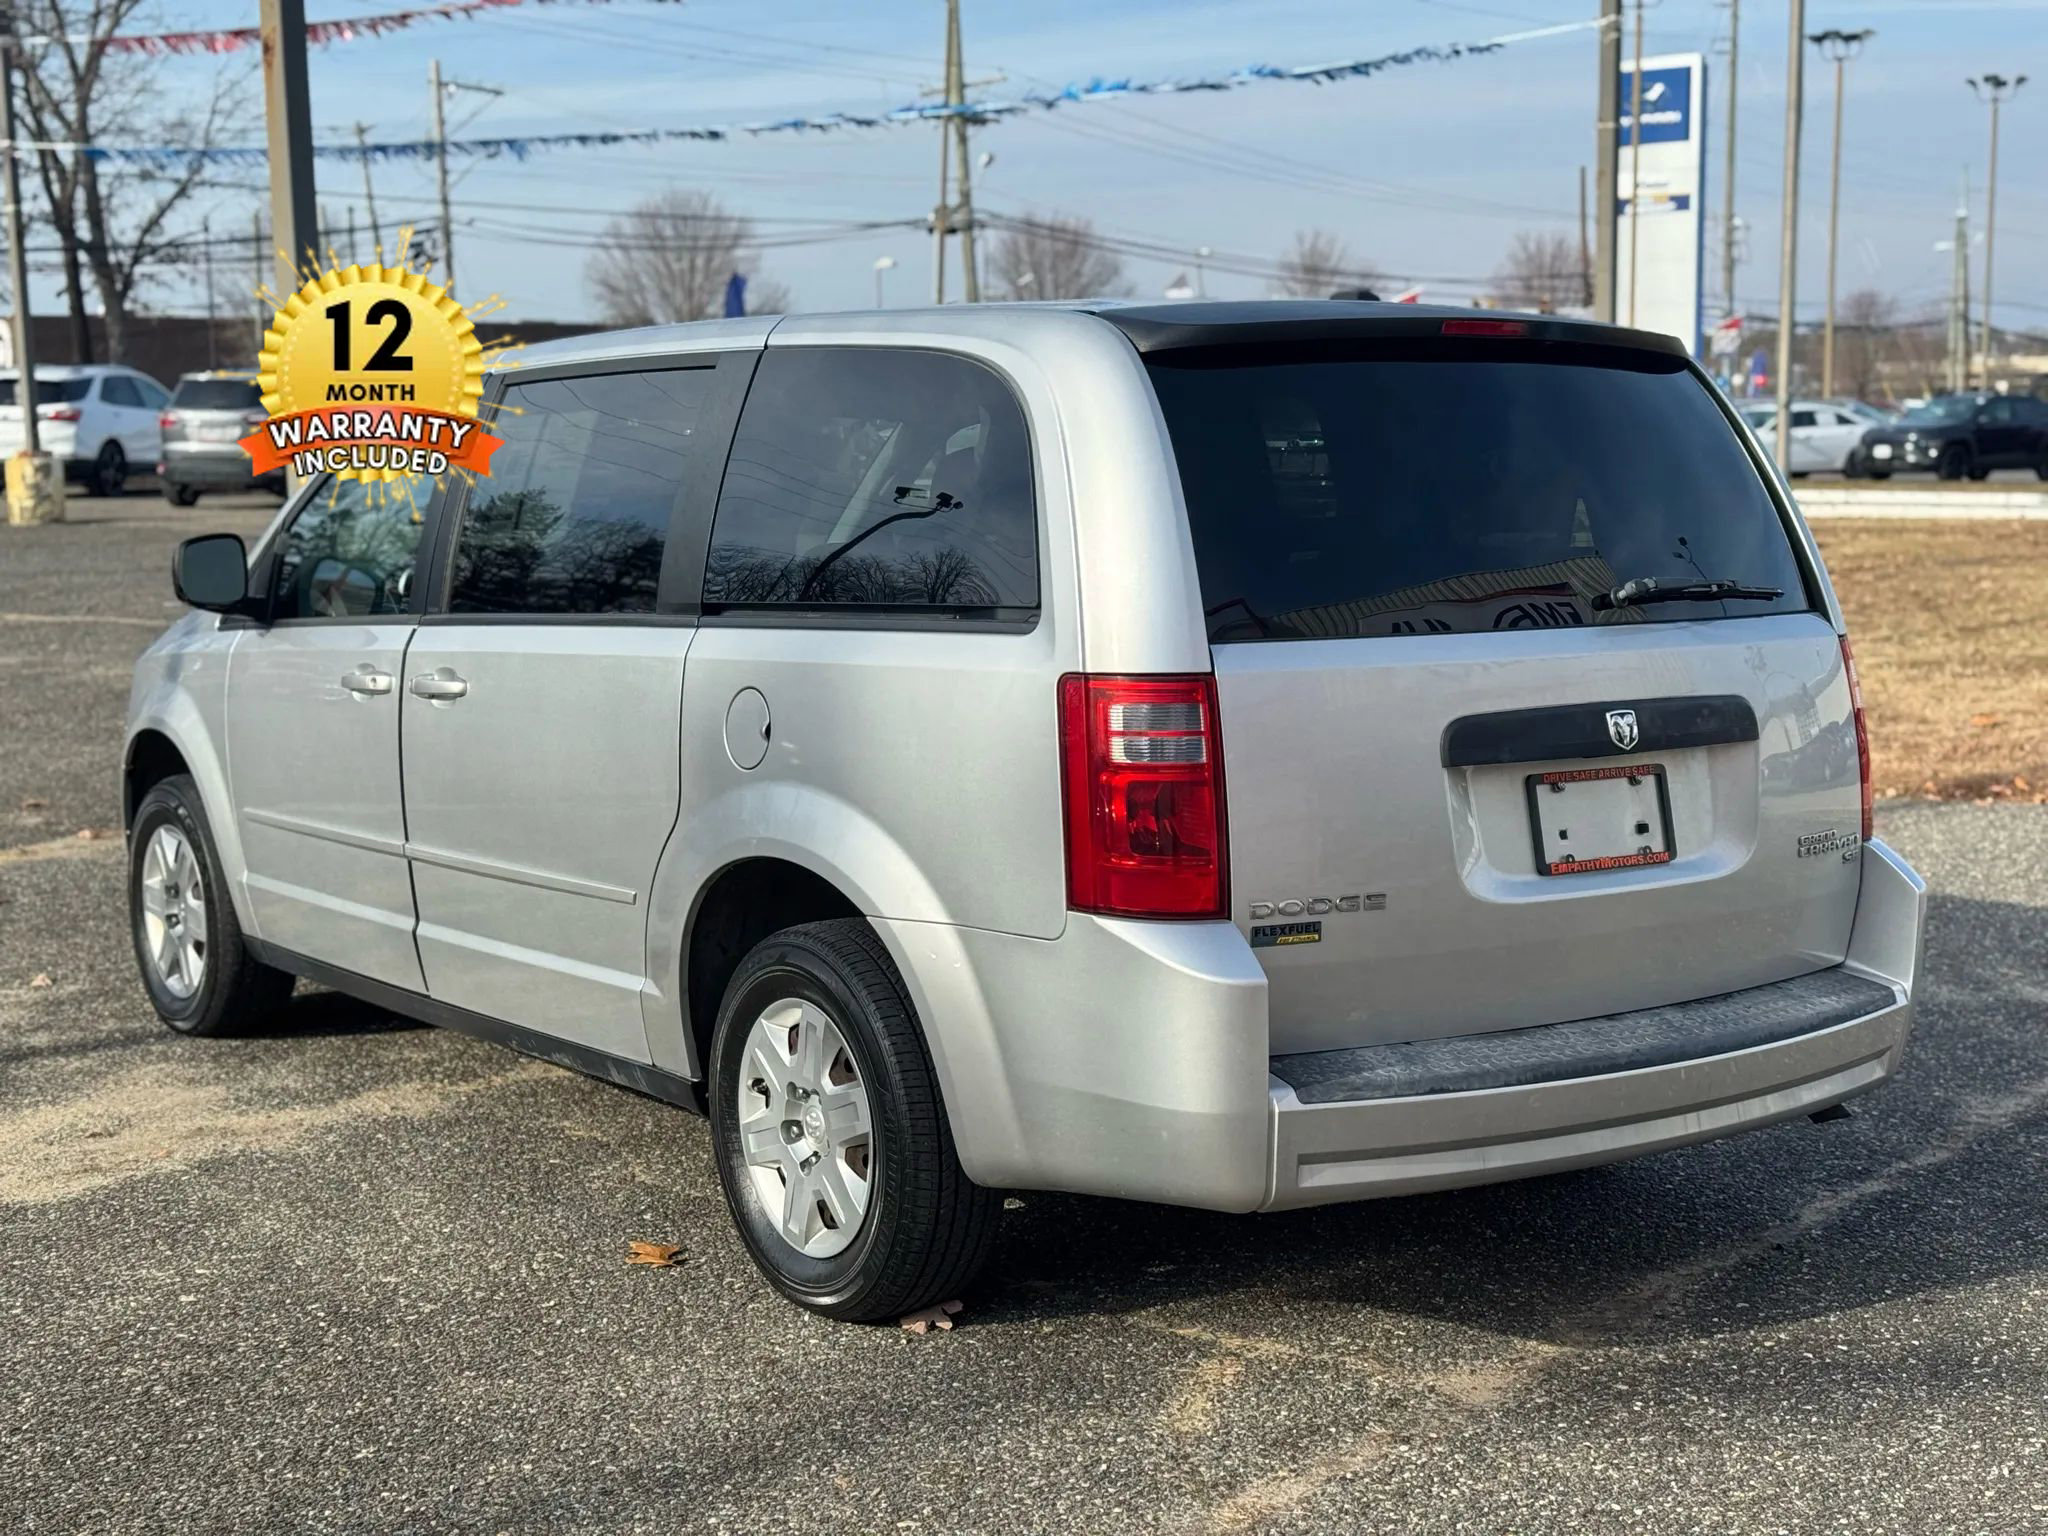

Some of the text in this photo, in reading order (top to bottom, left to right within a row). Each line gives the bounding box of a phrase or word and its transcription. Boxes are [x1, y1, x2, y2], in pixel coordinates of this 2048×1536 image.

[1543, 765, 1656, 784] DRIVE SAFE ARRIVE SAFE
[1249, 893, 1387, 920] DODGE
[1253, 923, 1320, 937] FLEXFUEL
